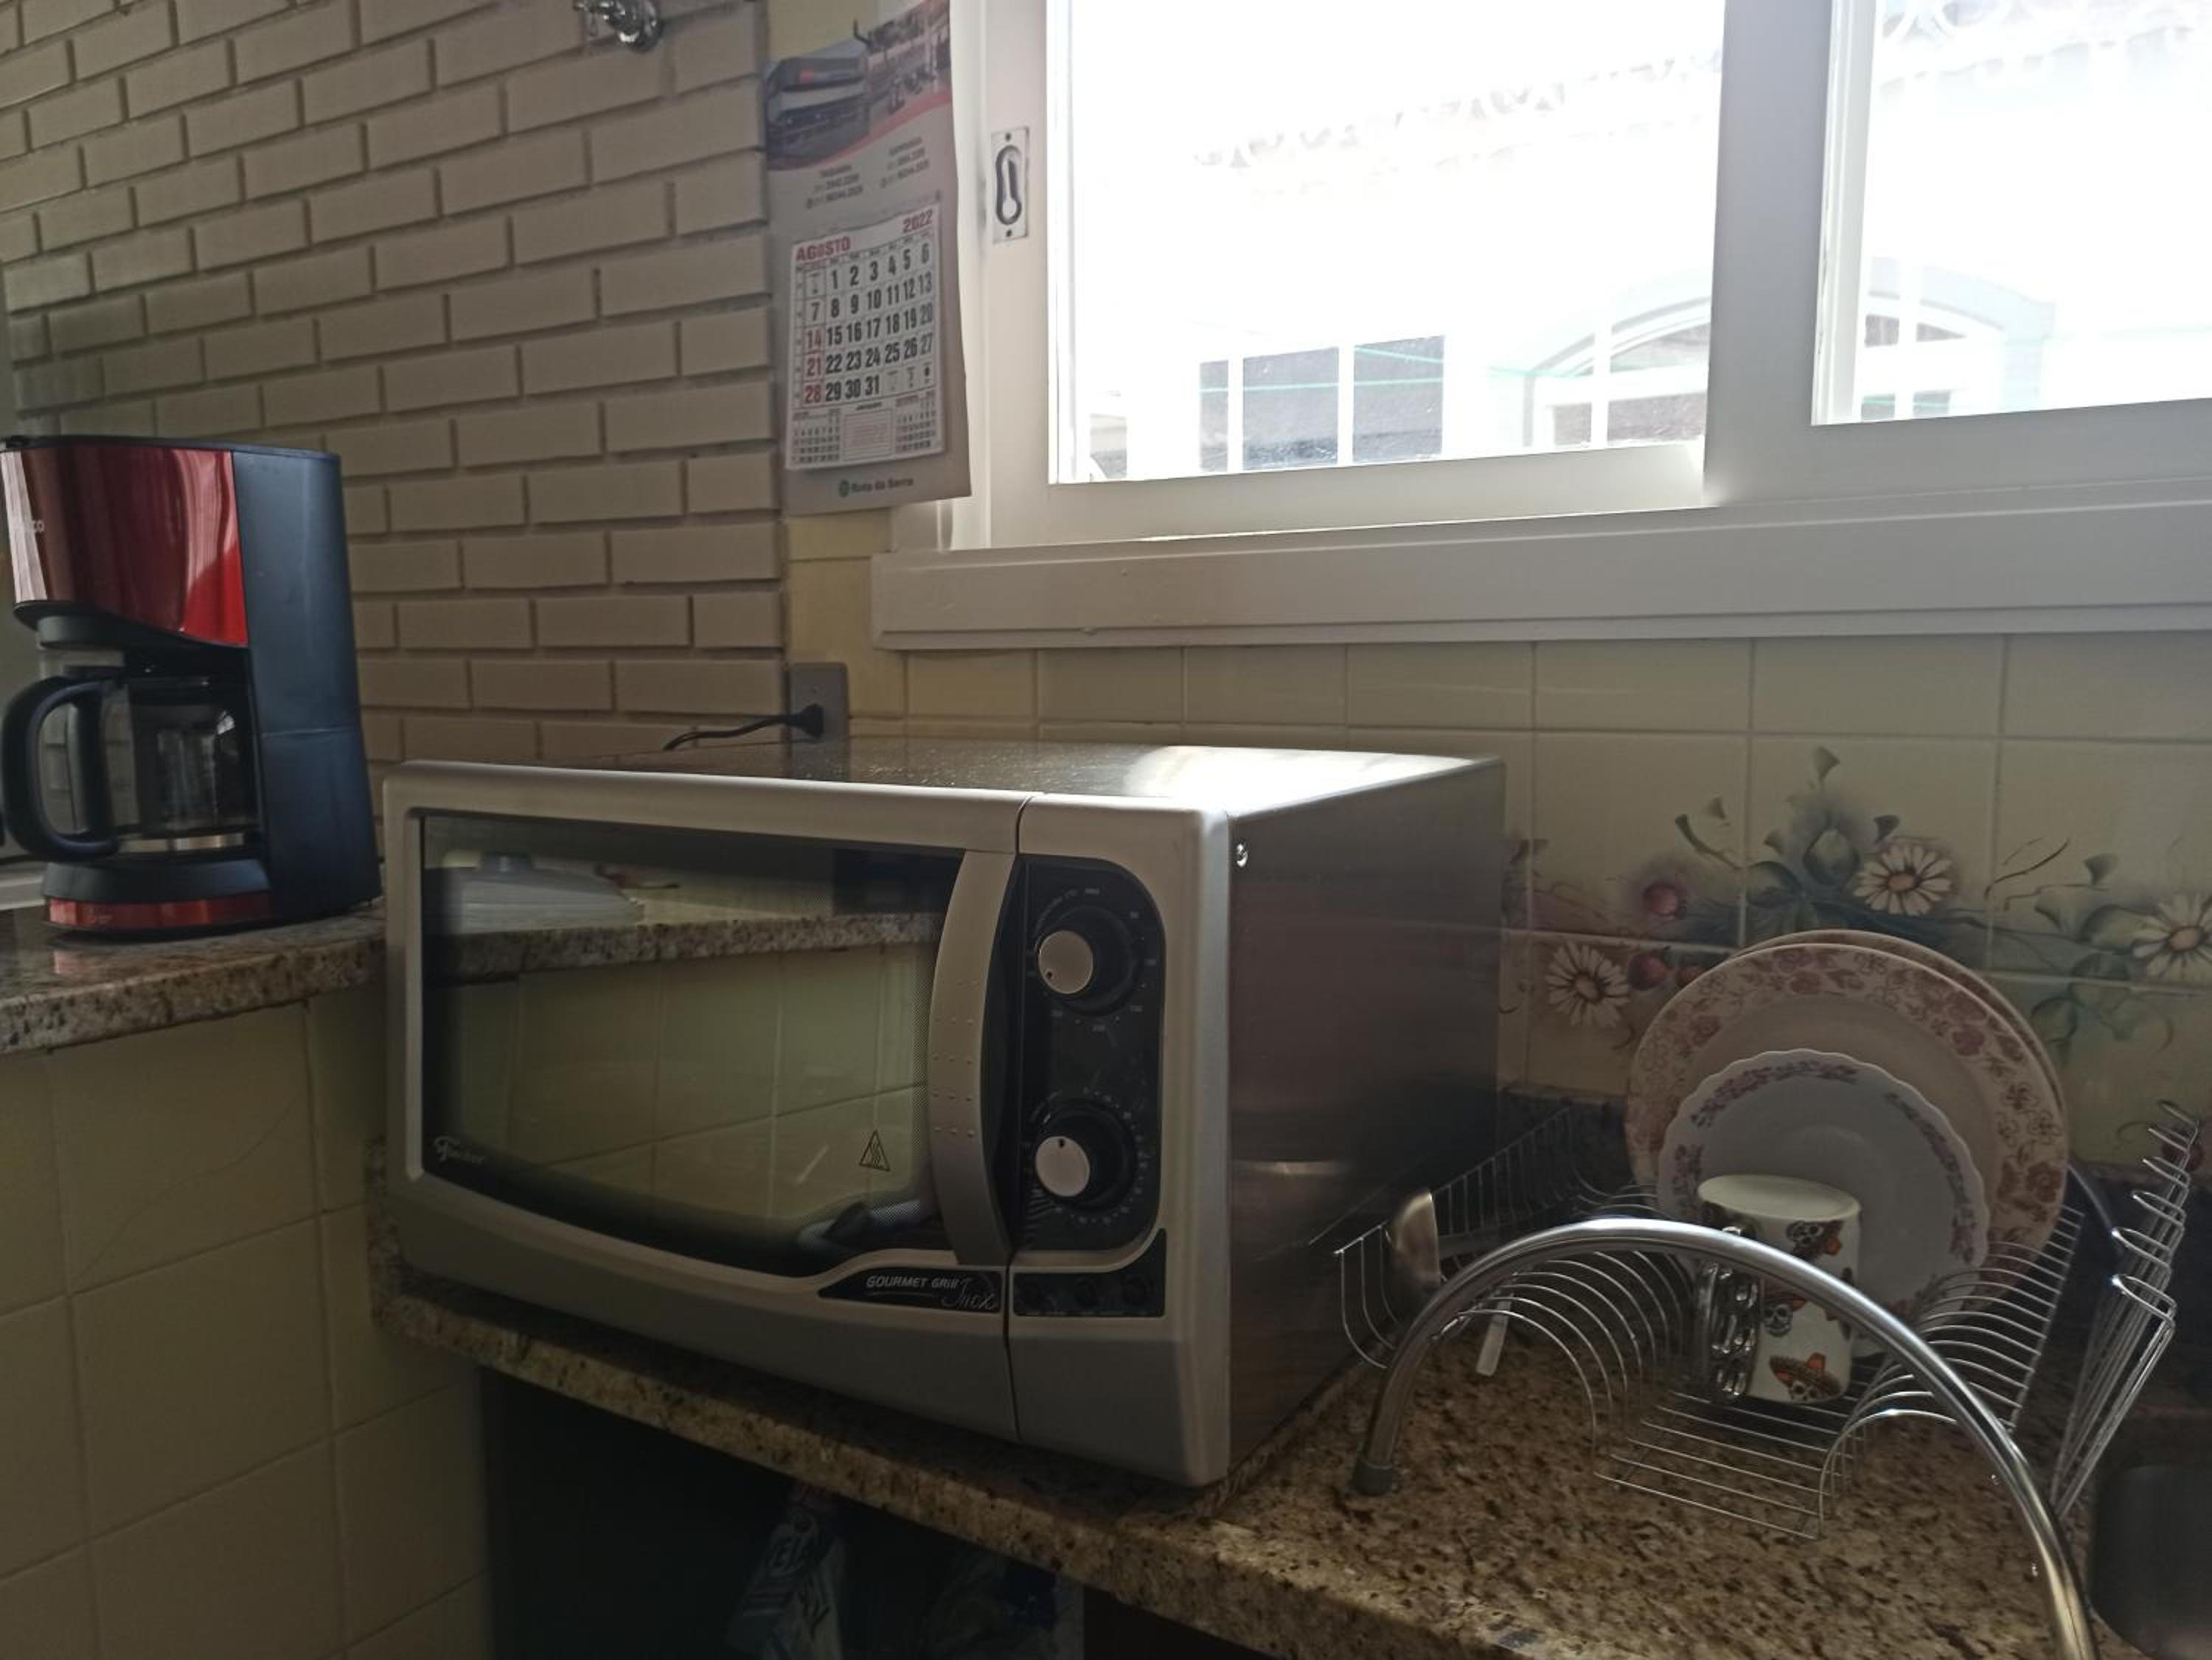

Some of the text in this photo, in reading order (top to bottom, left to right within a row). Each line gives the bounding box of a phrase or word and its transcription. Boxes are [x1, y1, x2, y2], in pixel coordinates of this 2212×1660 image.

[902, 210, 933, 233] 2022
[796, 236, 851, 261] AGOSTO
[831, 271, 838, 289] 1
[849, 266, 858, 286] 2
[870, 261, 878, 281] 3
[888, 256, 896, 275] 4
[903, 249, 911, 270] 5
[922, 243, 929, 263] 6
[811, 271, 932, 321] 7 8 9 10 11 12 13
[807, 304, 933, 349] 14 15 16 17 18 19 20
[807, 333, 933, 376] 21 22 23 24 25 26 27
[805, 385, 822, 404] 28
[826, 382, 841, 401] 29
[846, 379, 860, 398] 30
[866, 376, 880, 395] 31
[866, 1275, 928, 1288] GOURMET
